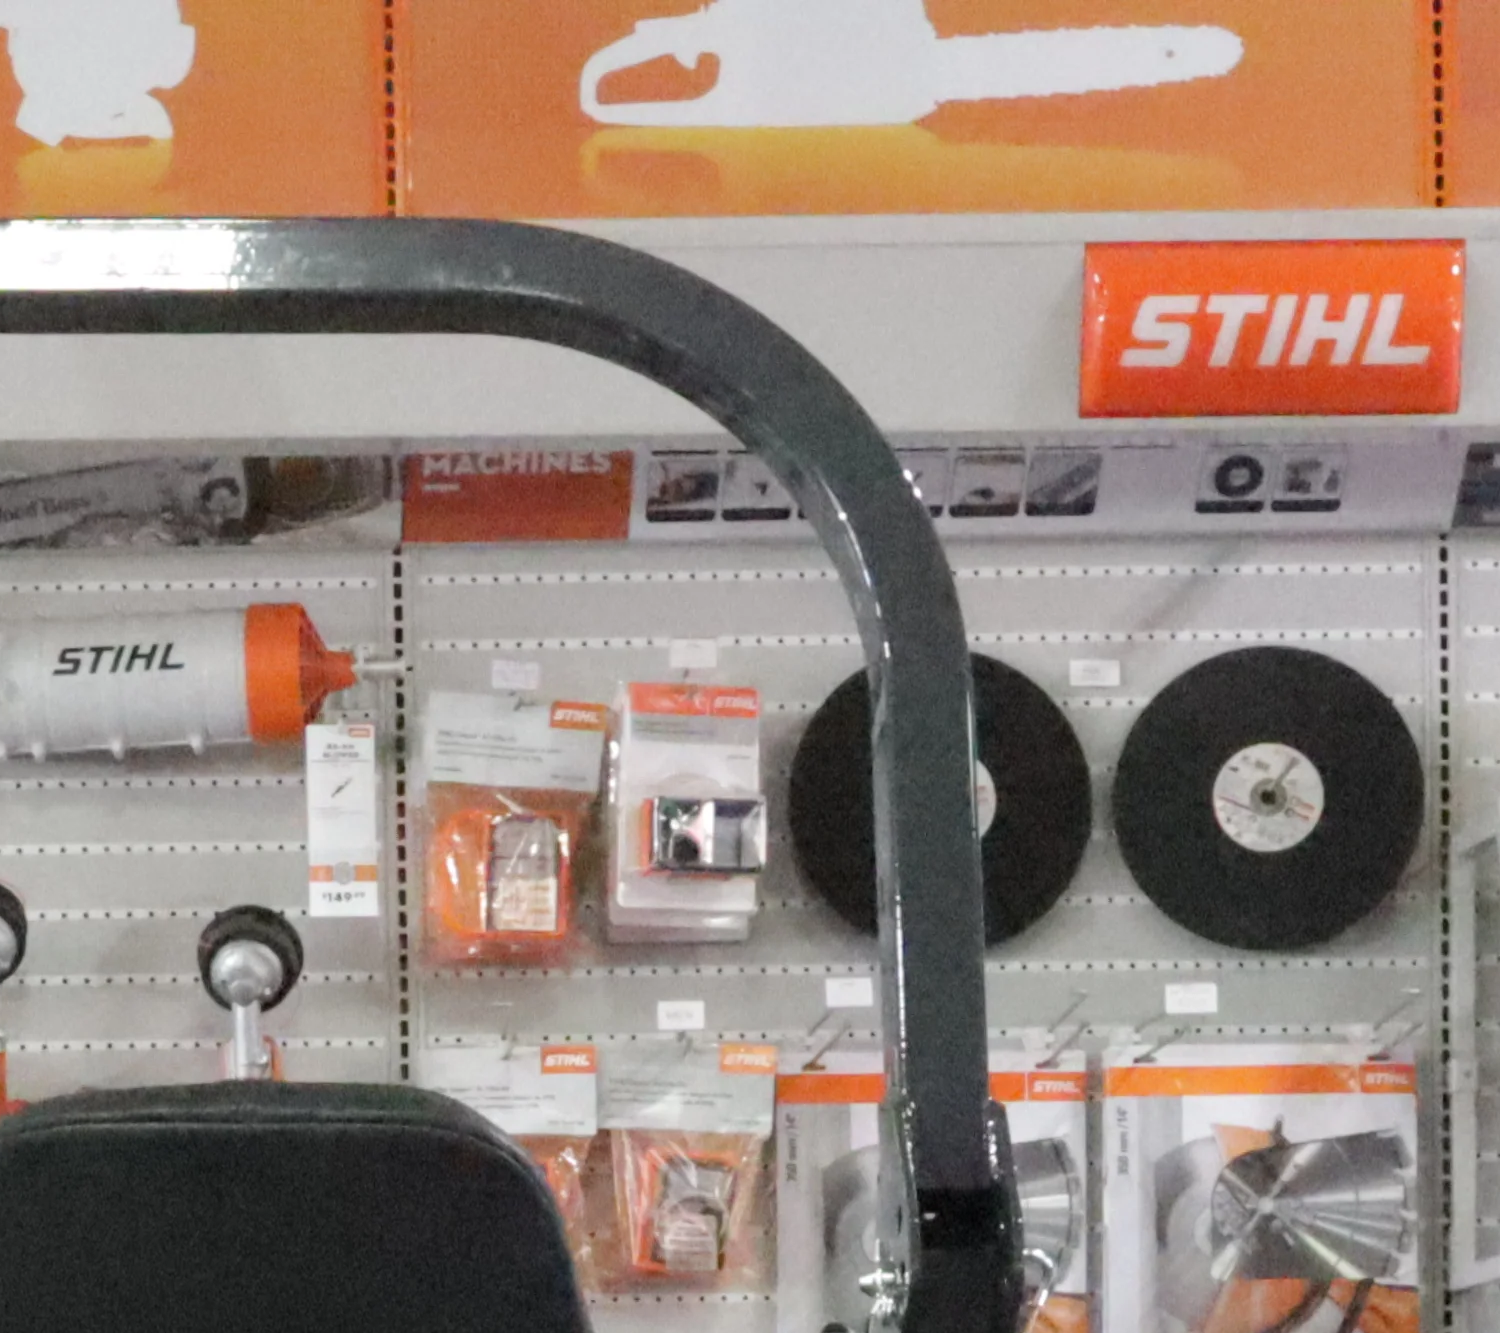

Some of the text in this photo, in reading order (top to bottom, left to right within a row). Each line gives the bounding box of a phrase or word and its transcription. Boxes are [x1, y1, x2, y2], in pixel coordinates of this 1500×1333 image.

[1119, 292, 1431, 368] STIHL
[421, 450, 613, 477] MACHINES
[52, 642, 186, 677] STIHL
[552, 708, 601, 724] STIHL
[544, 1053, 591, 1067] STIHL
[1032, 1079, 1080, 1094] STIHL
